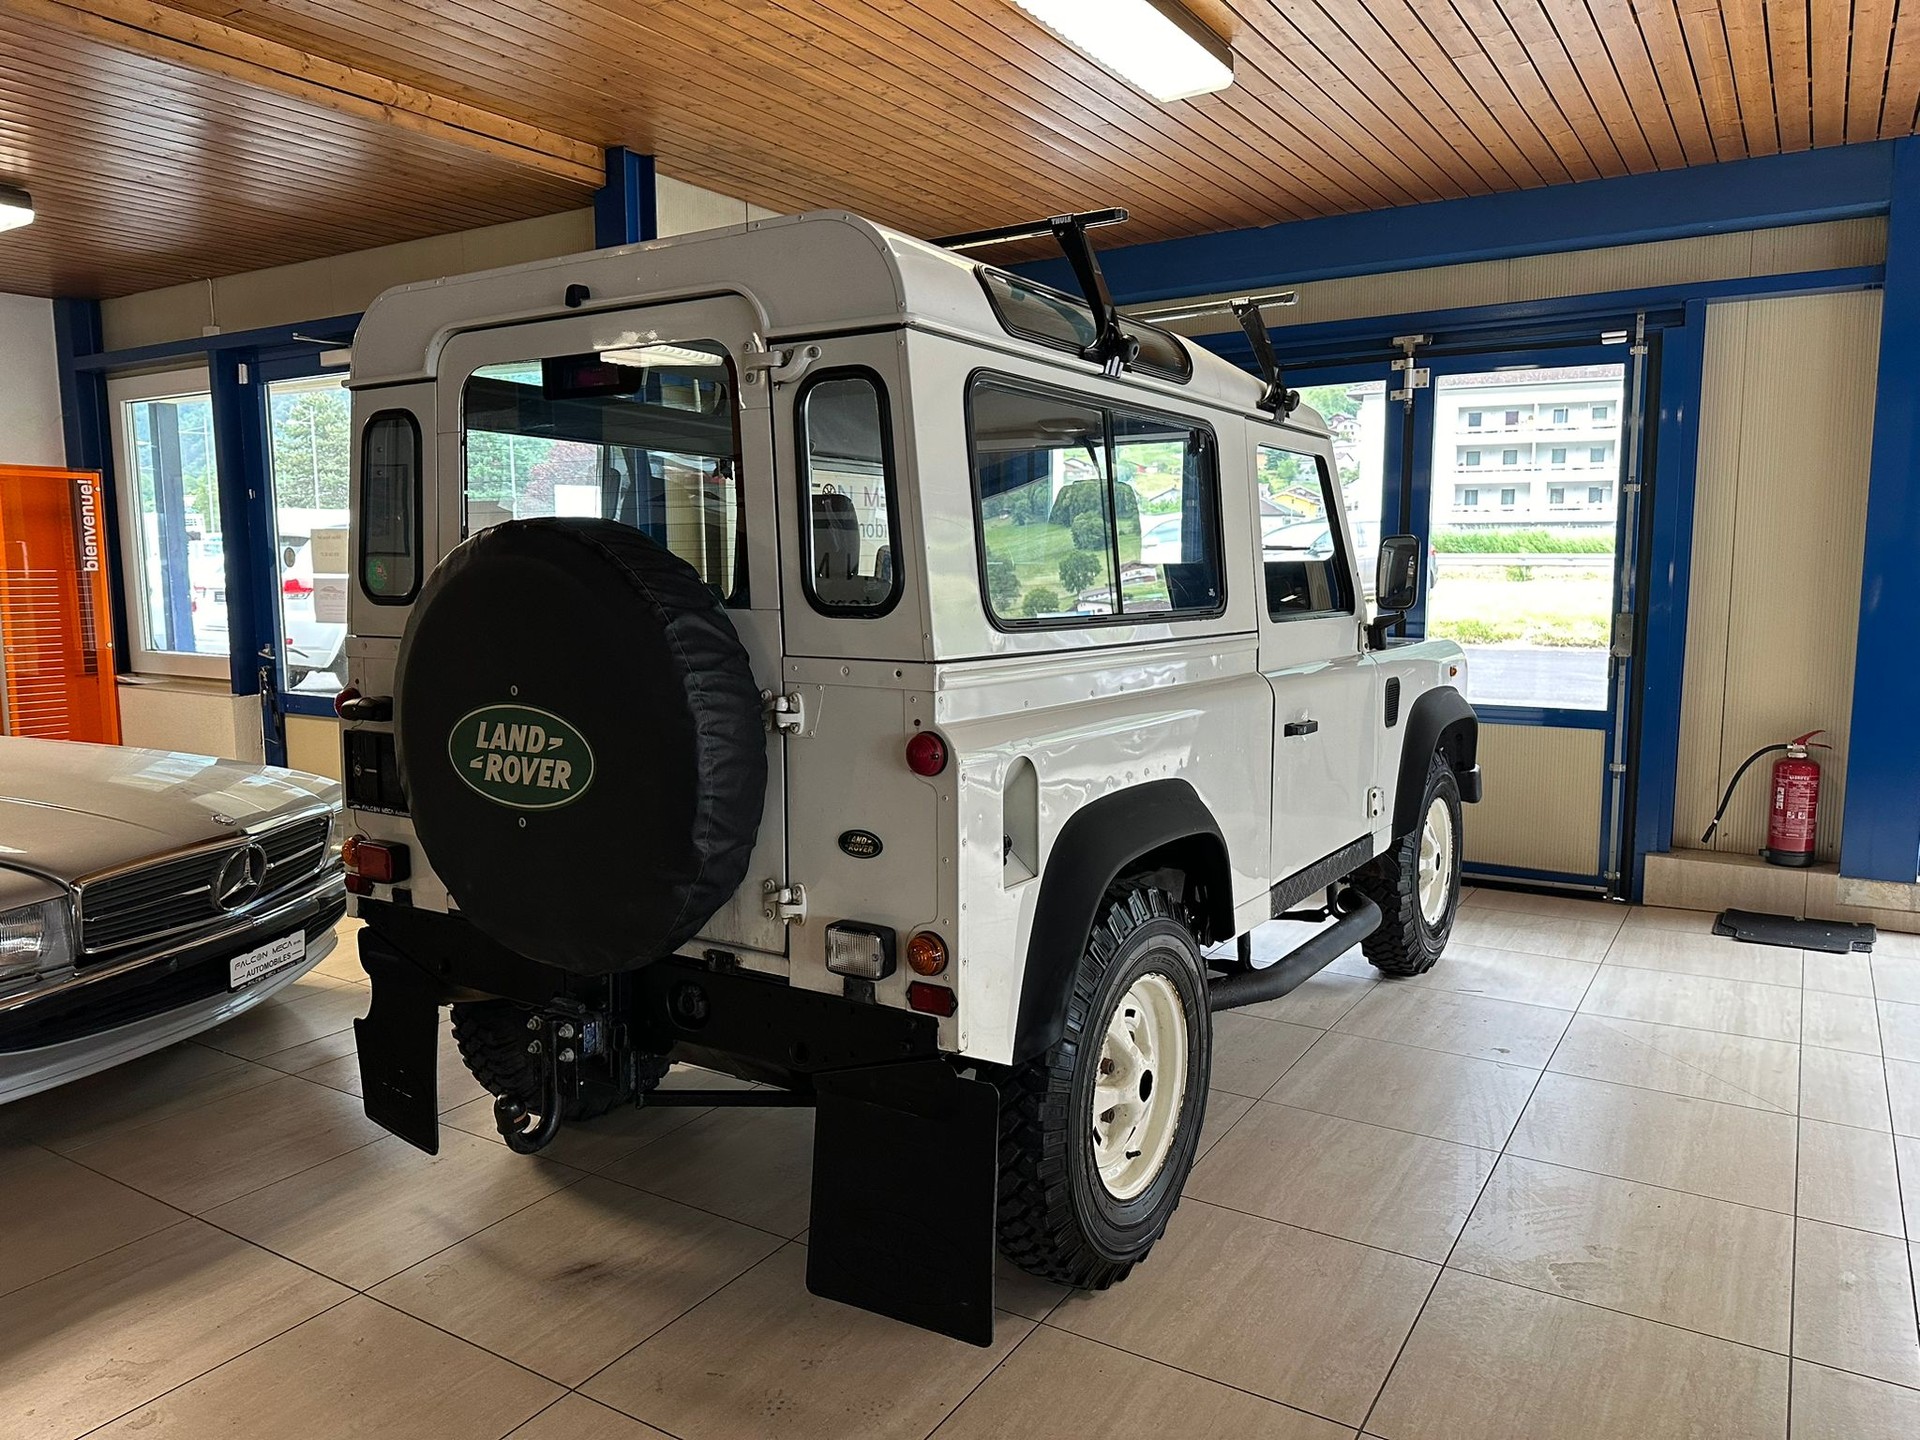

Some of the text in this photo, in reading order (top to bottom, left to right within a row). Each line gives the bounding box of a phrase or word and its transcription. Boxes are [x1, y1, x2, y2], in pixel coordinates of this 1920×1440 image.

[1051, 215, 1072, 225] THULE
[77, 479, 99, 572] bienvenue!
[235, 951, 269, 971] FALCON
[272, 940, 293, 955] MECA
[246, 952, 292, 978] AUTOMOBILES
